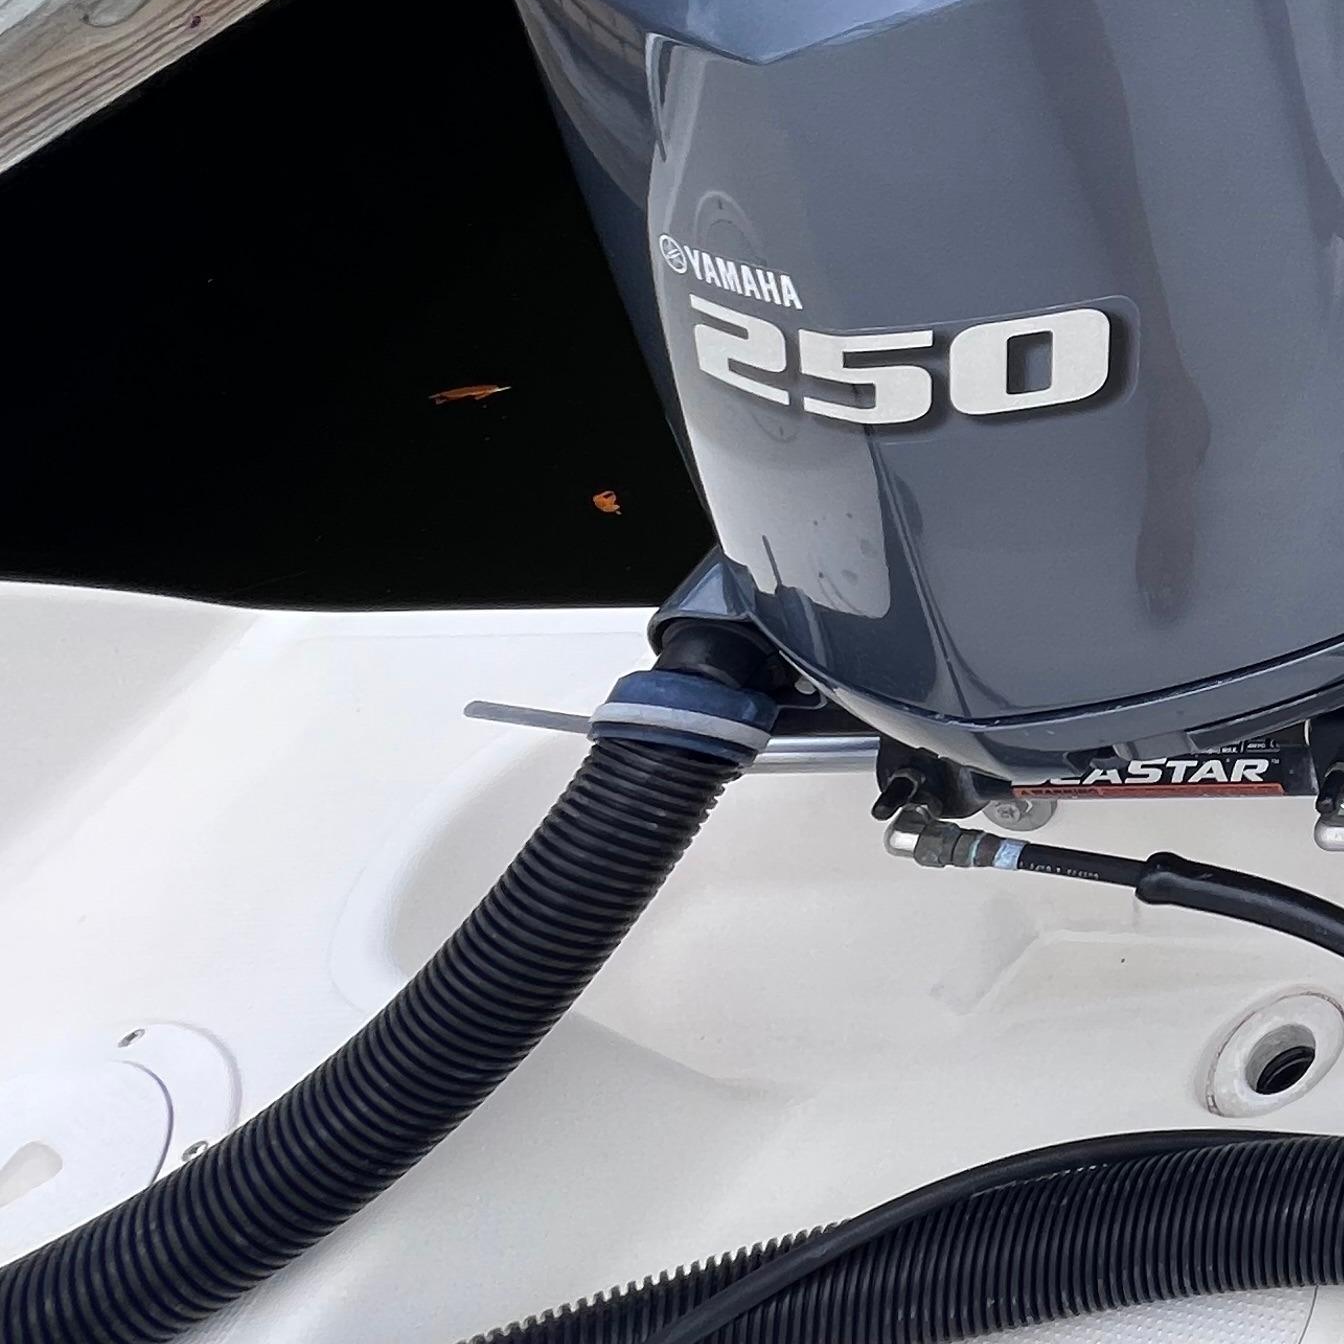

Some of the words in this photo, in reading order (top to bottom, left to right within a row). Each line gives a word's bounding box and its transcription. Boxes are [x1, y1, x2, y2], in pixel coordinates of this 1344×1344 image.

[684, 246, 803, 310] YAMAHA
[688, 293, 1110, 425] 250
[1048, 758, 1270, 785] ASTAR
